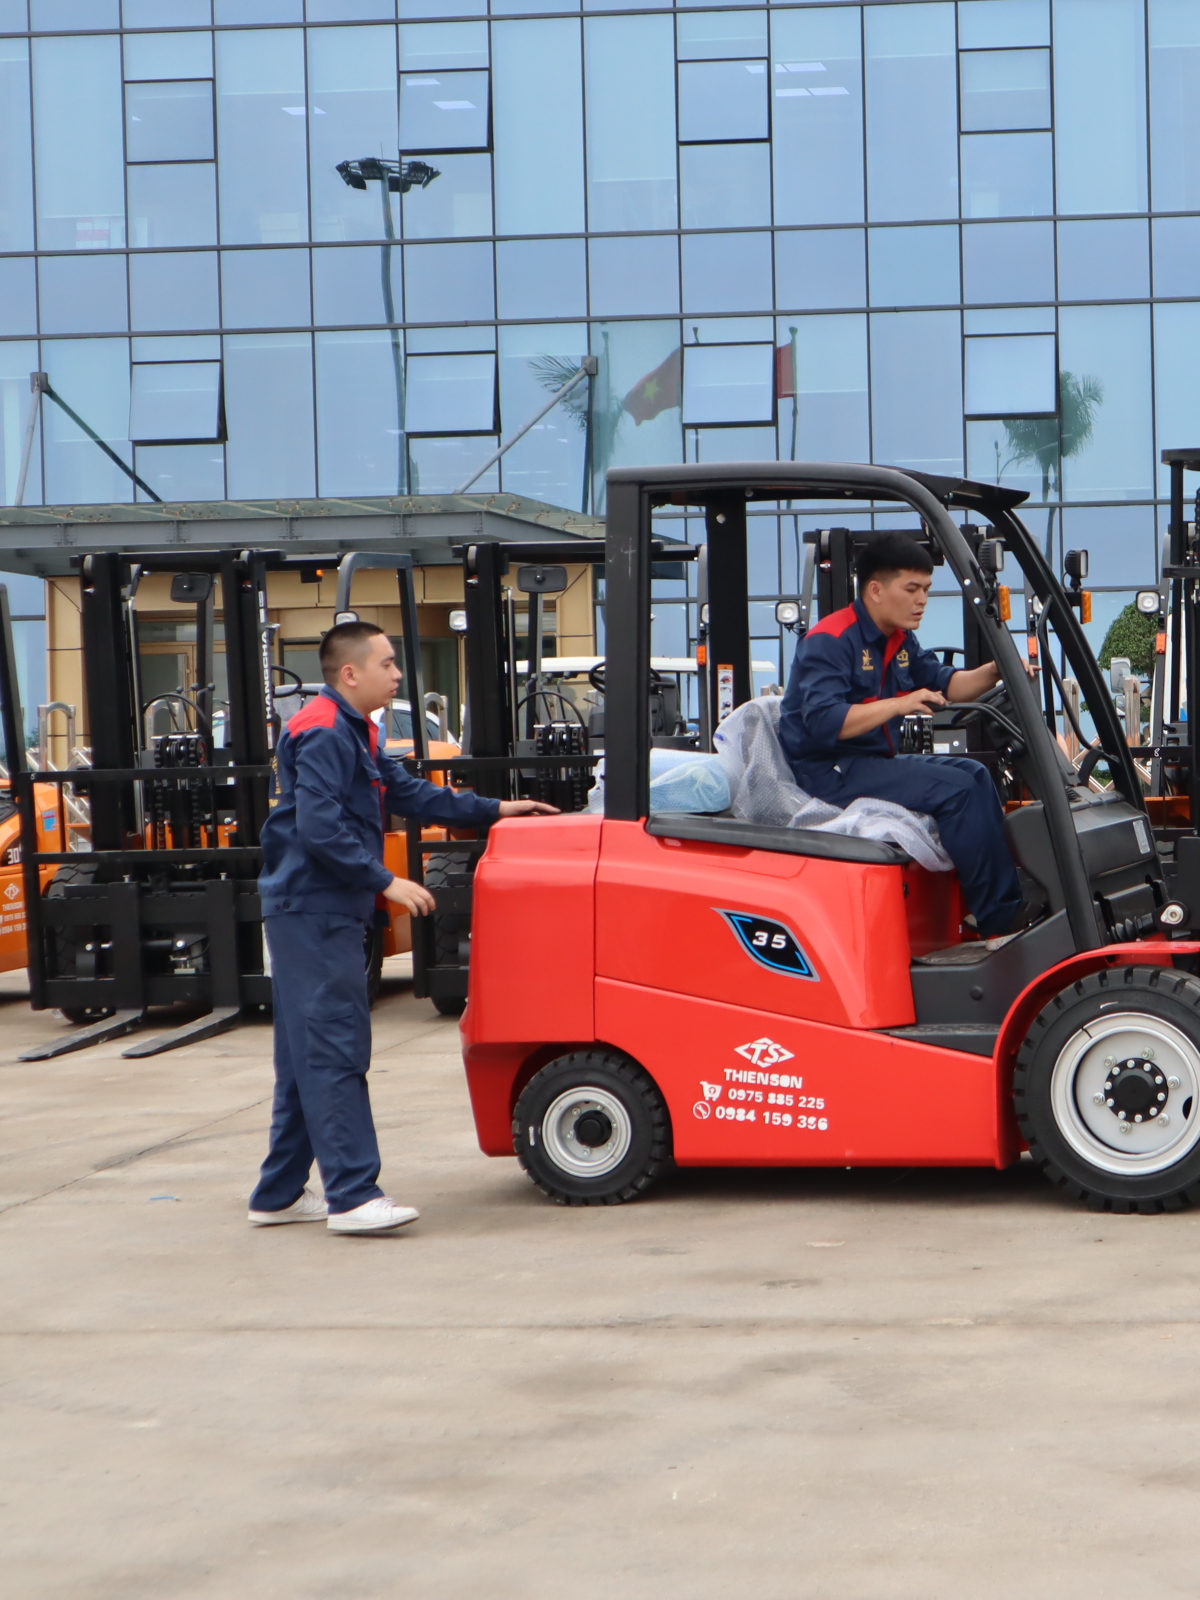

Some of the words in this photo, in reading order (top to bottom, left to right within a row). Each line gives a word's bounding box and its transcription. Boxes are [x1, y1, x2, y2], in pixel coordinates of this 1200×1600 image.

[261, 630, 274, 720] HANGCHA
[752, 931, 787, 949] 35
[723, 1068, 804, 1089] THIENSON
[728, 1088, 764, 1103] 0975
[767, 1092, 795, 1107] 885
[797, 1096, 826, 1110] 225
[715, 1105, 757, 1122] 0984
[762, 1111, 793, 1127] 159
